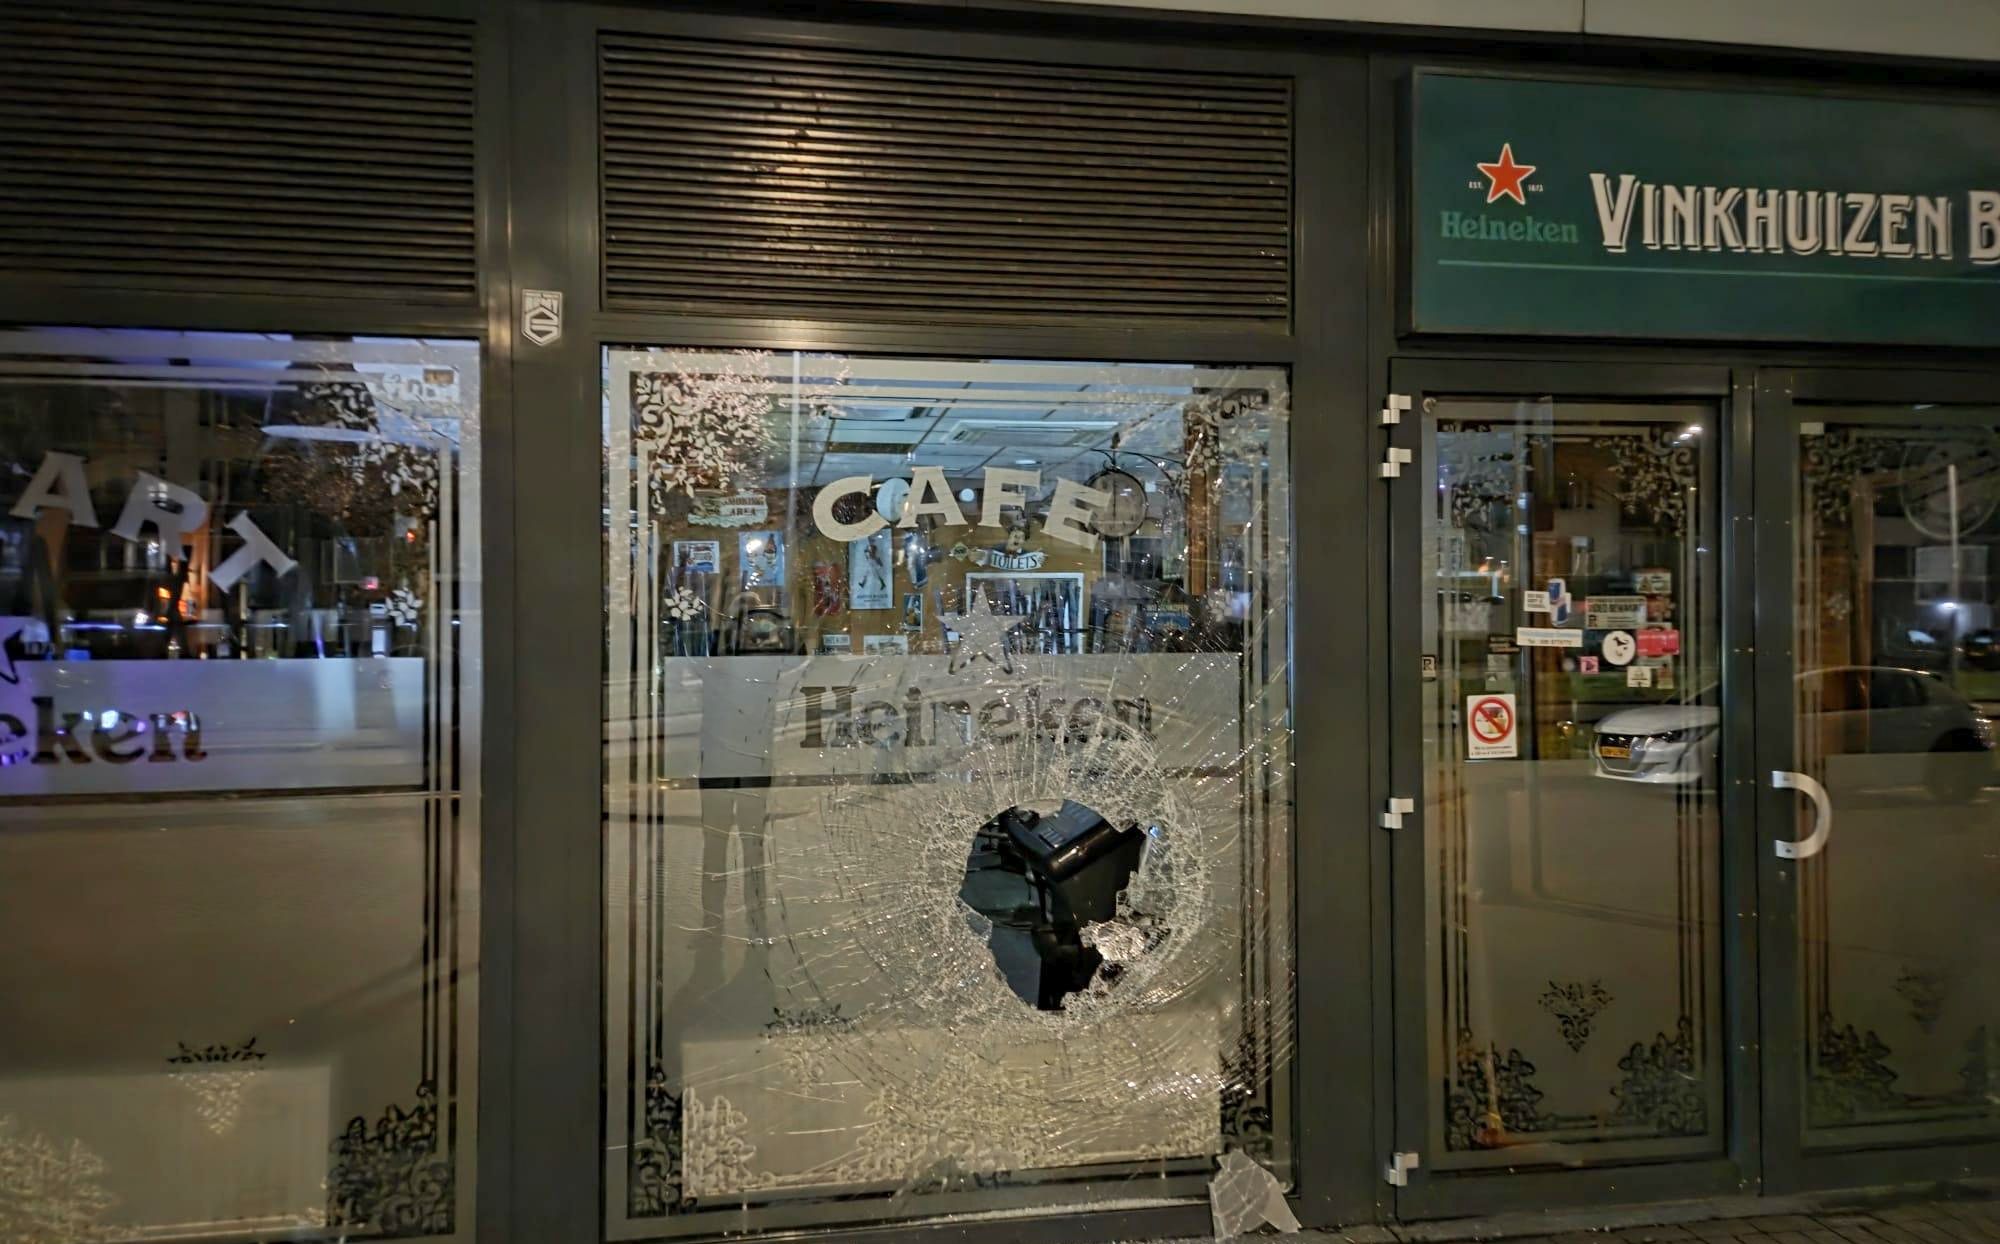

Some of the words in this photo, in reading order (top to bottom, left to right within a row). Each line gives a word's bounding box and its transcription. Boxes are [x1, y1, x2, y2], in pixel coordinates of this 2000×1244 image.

[1440, 211, 1580, 245] Heineken
[1589, 173, 1953, 260] VINKHUIZEN
[9, 451, 299, 594] ART
[813, 466, 1112, 552] CAFE
[992, 553, 1038, 570] TOILETS
